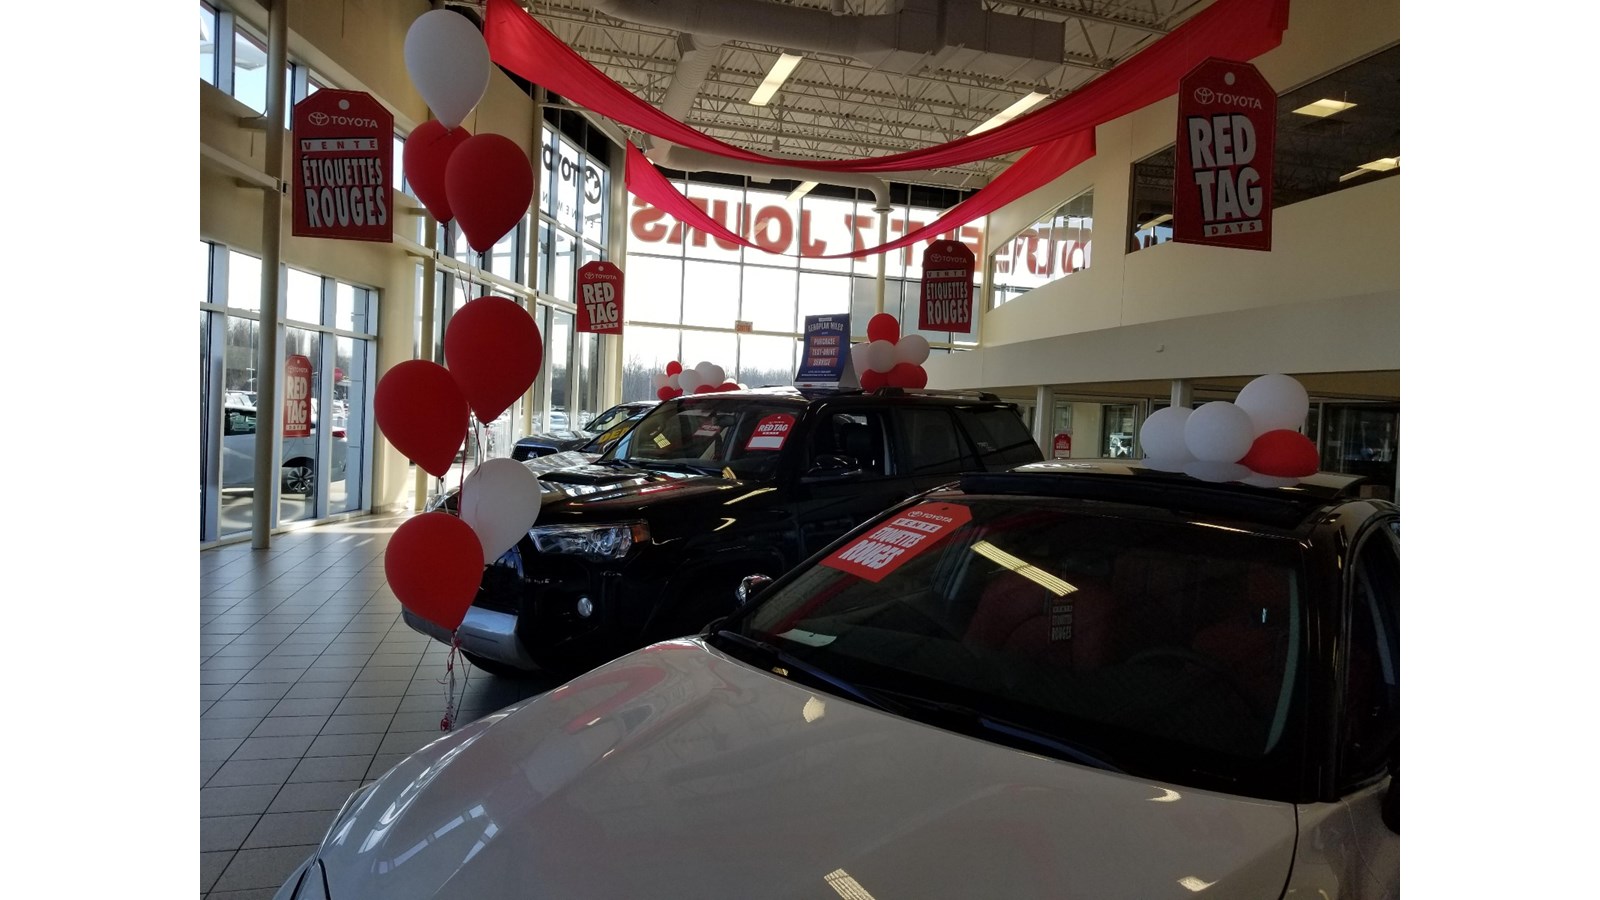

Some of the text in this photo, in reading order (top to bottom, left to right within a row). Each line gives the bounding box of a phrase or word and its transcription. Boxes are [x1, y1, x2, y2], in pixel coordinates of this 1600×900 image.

[1216, 93, 1262, 110] TOYOTA
[331, 115, 378, 129] TOYOTA
[304, 140, 376, 150] VENTE
[1188, 114, 1257, 169] RED
[302, 155, 383, 188] ÉTIQUETTES
[1195, 166, 1263, 221] TAG
[305, 186, 387, 228] ROUGES
[1211, 221, 1256, 235] DAYS
[943, 255, 967, 264] TOYOTA
[582, 282, 615, 304] RED
[926, 281, 968, 300] ÉTIQUETTES
[586, 302, 619, 324] TAG
[927, 299, 969, 325] ROUGES
[287, 376, 308, 400] RED
[286, 400, 307, 424] TAG
[757, 423, 788, 432] RED TAG
[895, 518, 938, 532] VENTE
[921, 512, 953, 523] TOYOTA
[838, 539, 905, 570] ROUGES
